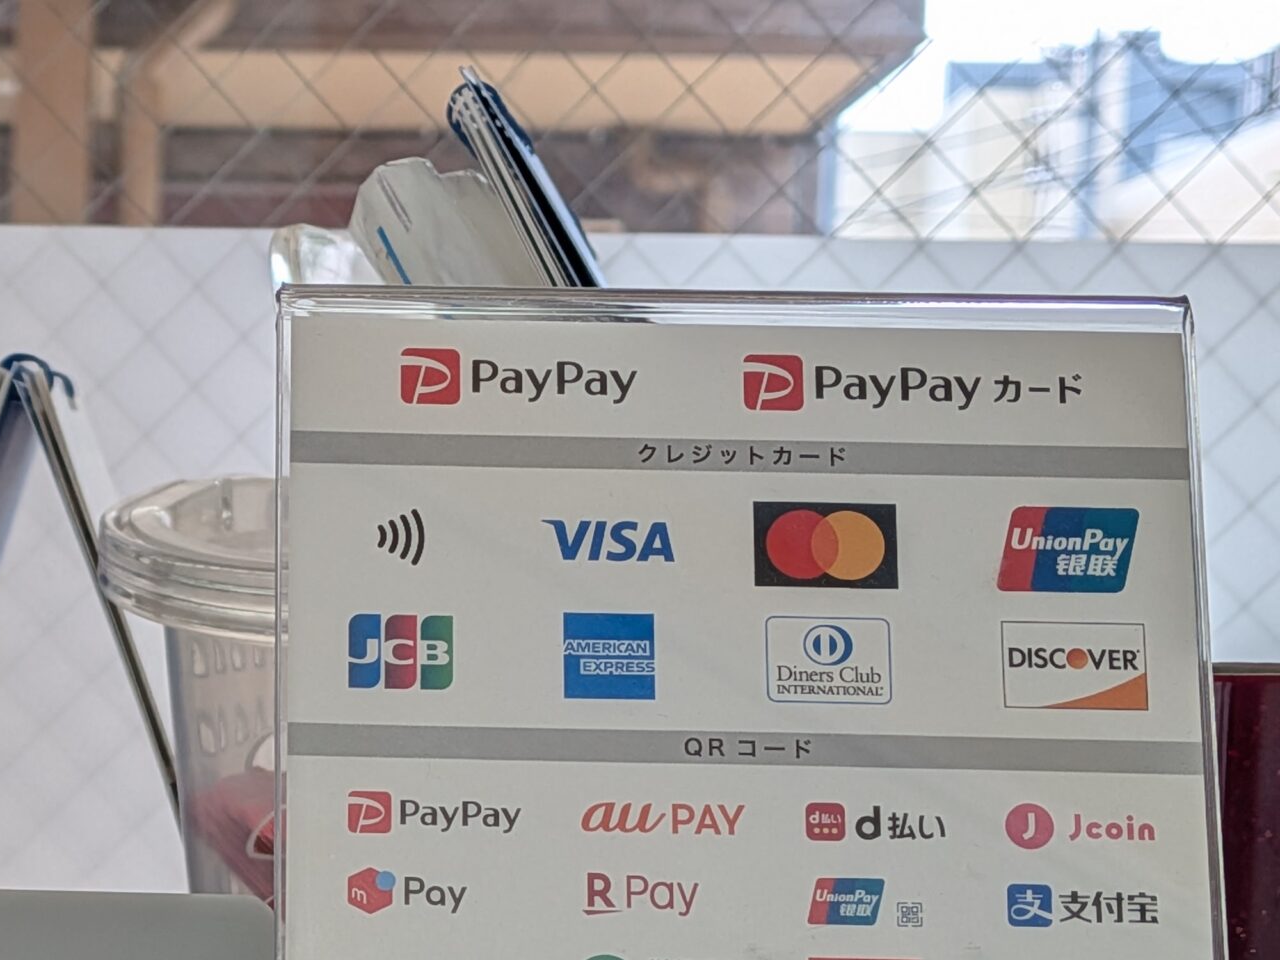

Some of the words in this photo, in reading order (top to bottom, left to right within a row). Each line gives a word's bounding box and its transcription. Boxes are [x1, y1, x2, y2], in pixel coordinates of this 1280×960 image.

[472, 359, 638, 404] PayPay
[814, 365, 982, 411] PayPay
[993, 373, 1083, 405] カード
[637, 443, 847, 467] クレジットカード
[541, 519, 675, 563] VISA
[1010, 527, 1129, 559] UnionPay
[1055, 553, 1119, 577] 银联
[347, 638, 451, 666] JCB
[564, 641, 648, 655] AMERICAN
[1007, 646, 1141, 671] DISCOVER
[582, 660, 656, 674] EXPRESS
[776, 665, 834, 683] Diners
[838, 665, 882, 684] Club
[684, 737, 725, 757] QR
[738, 738, 812, 760] コード
[399, 800, 521, 833] PayPay
[580, 801, 666, 833] au
[671, 803, 746, 836] PAY
[1068, 814, 1155, 841] Jcoin
[403, 875, 468, 914] Pay
[625, 874, 700, 916] Pay
[816, 888, 879, 904] UnionPay
[1058, 890, 1160, 924] 支付宝
